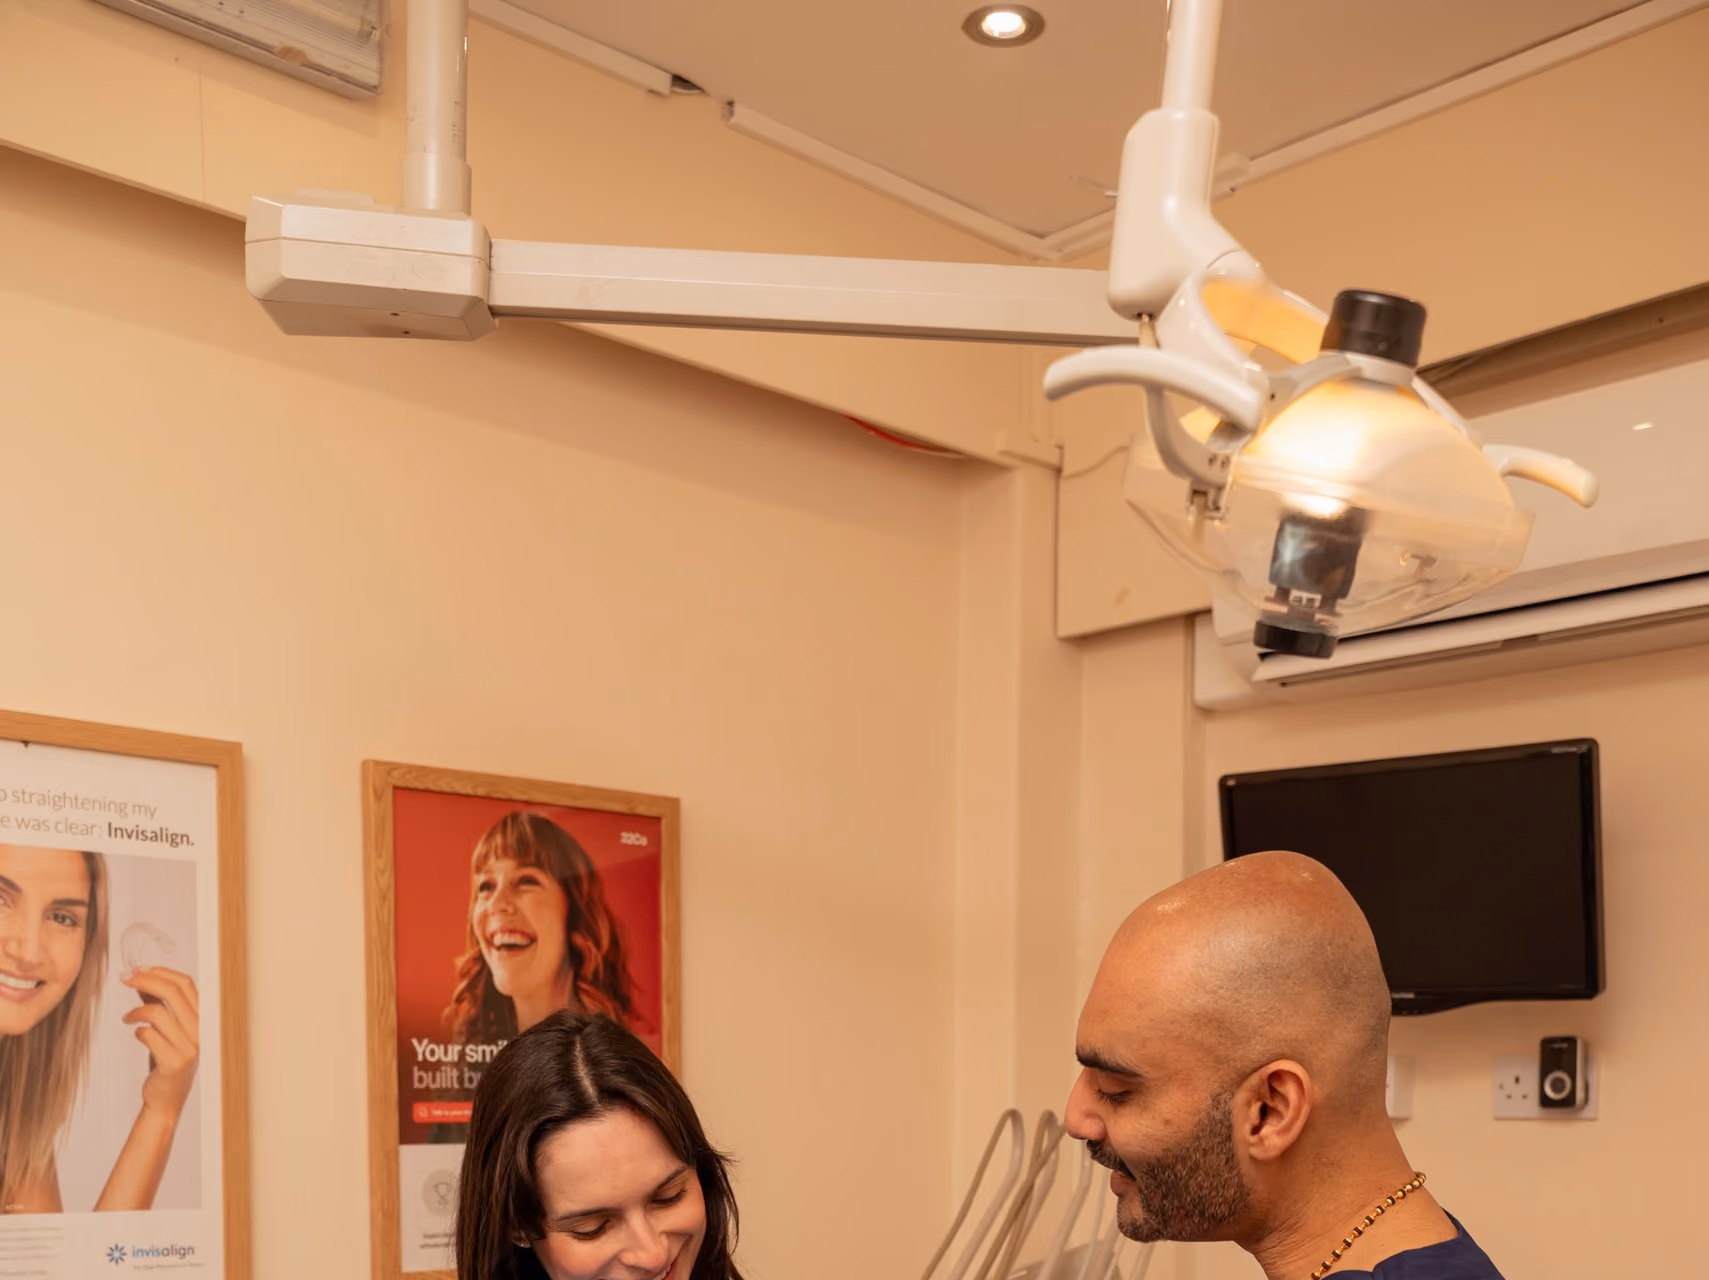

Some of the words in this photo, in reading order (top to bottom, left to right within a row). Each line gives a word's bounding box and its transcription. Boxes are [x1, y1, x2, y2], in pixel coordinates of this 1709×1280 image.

[12, 788, 128, 818] straightening
[132, 803, 157, 820] my
[15, 816, 50, 832] was
[107, 822, 195, 848] Invisalign.
[411, 1038, 462, 1062] Your
[413, 1066, 459, 1089] built
[132, 1245, 196, 1260] invisalign
